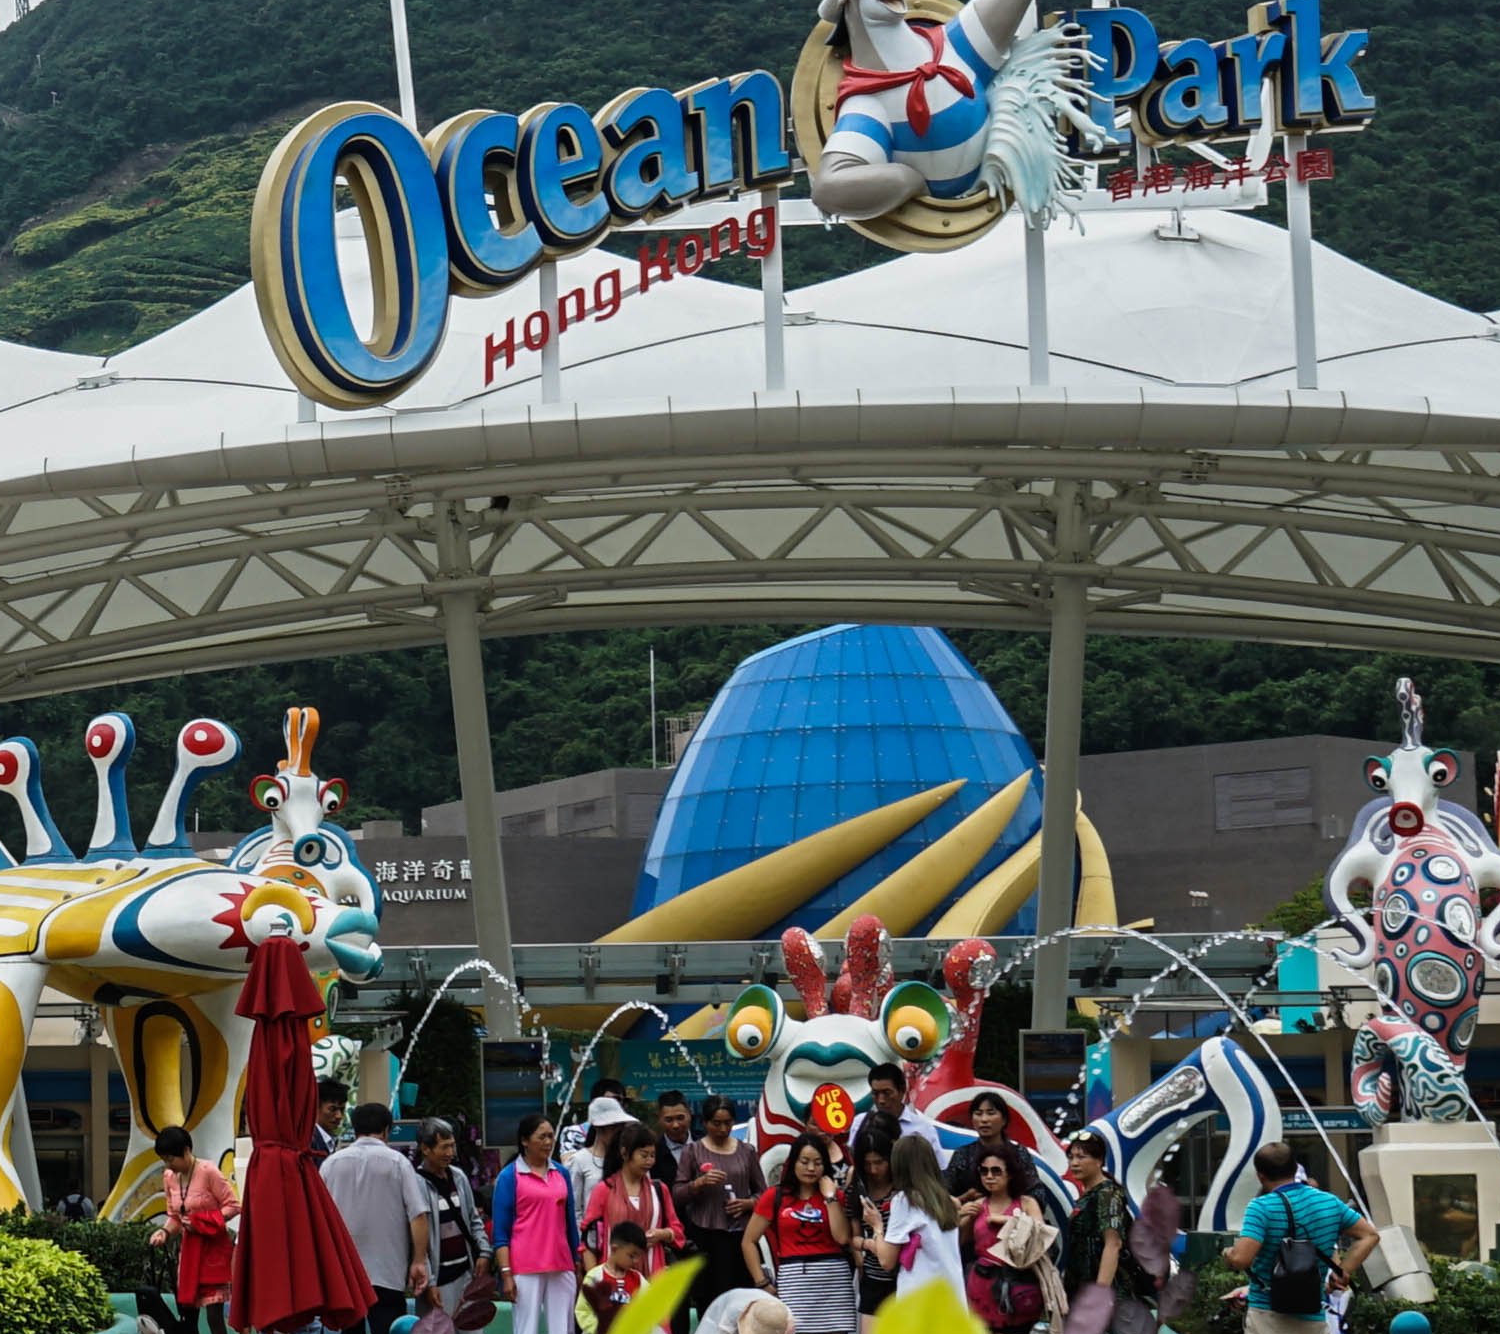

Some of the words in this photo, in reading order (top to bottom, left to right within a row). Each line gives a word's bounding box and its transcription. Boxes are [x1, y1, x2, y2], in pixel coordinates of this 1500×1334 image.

[1106, 148, 1333, 203] 香港海洋公園
[252, 69, 792, 409] Ocean
[484, 267, 623, 389] Hong
[638, 205, 777, 295] Kong
[381, 888, 467, 904] AQUARIUM
[815, 1088, 841, 1107] VIP
[825, 1101, 847, 1129] 6
